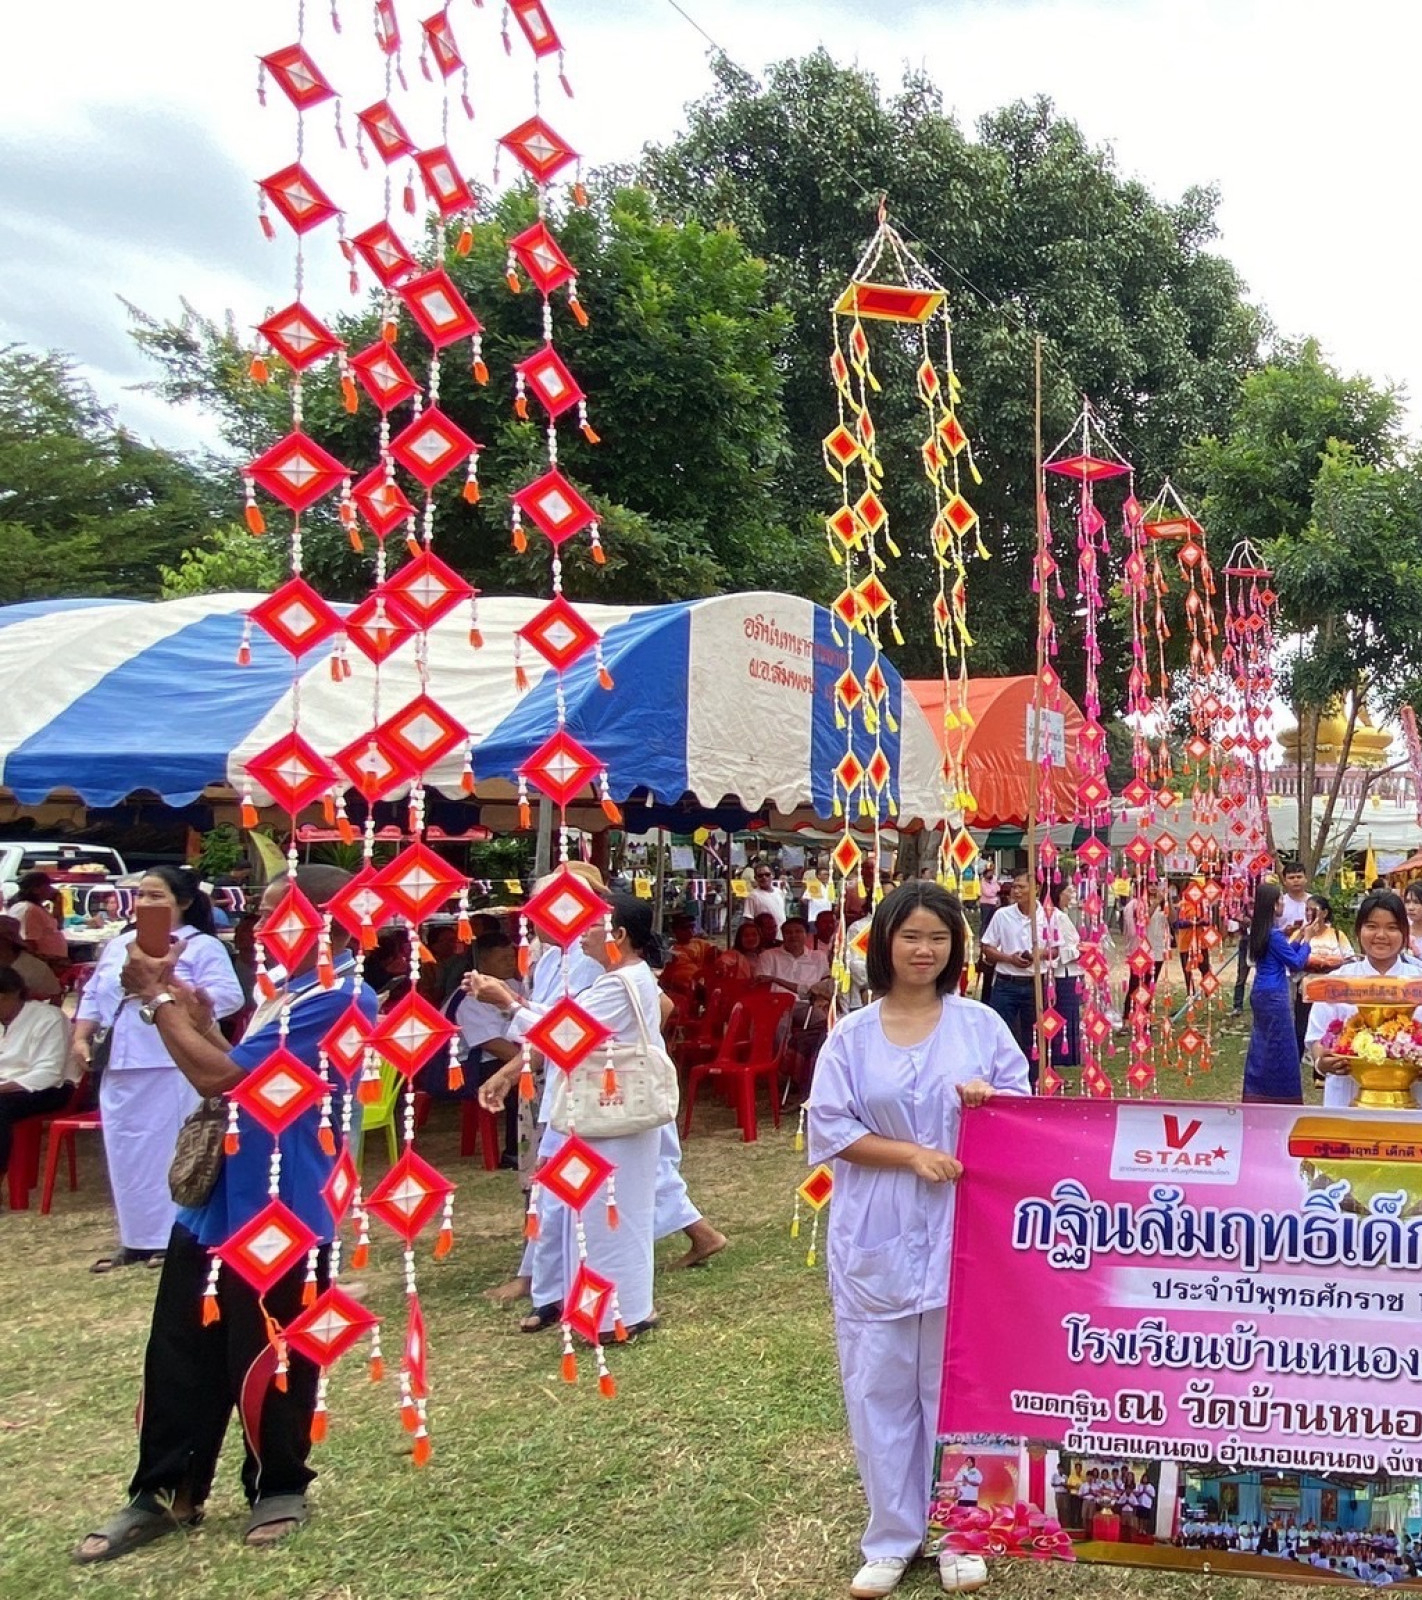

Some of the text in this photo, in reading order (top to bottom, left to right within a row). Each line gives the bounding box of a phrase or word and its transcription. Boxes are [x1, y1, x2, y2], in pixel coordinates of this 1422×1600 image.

[1163, 1114, 1203, 1150] V
[1134, 1149, 1212, 1166] STAR
[1152, 1276, 1405, 1313] ประจำปีพุทธศักราช
[1013, 1391, 1109, 1423] ทอดกฐิน
[1118, 1392, 1164, 1422] ณ
[1067, 1427, 1209, 1460] ตำบลแคนดง
[1219, 1437, 1376, 1471] อำเภอแคนดง
